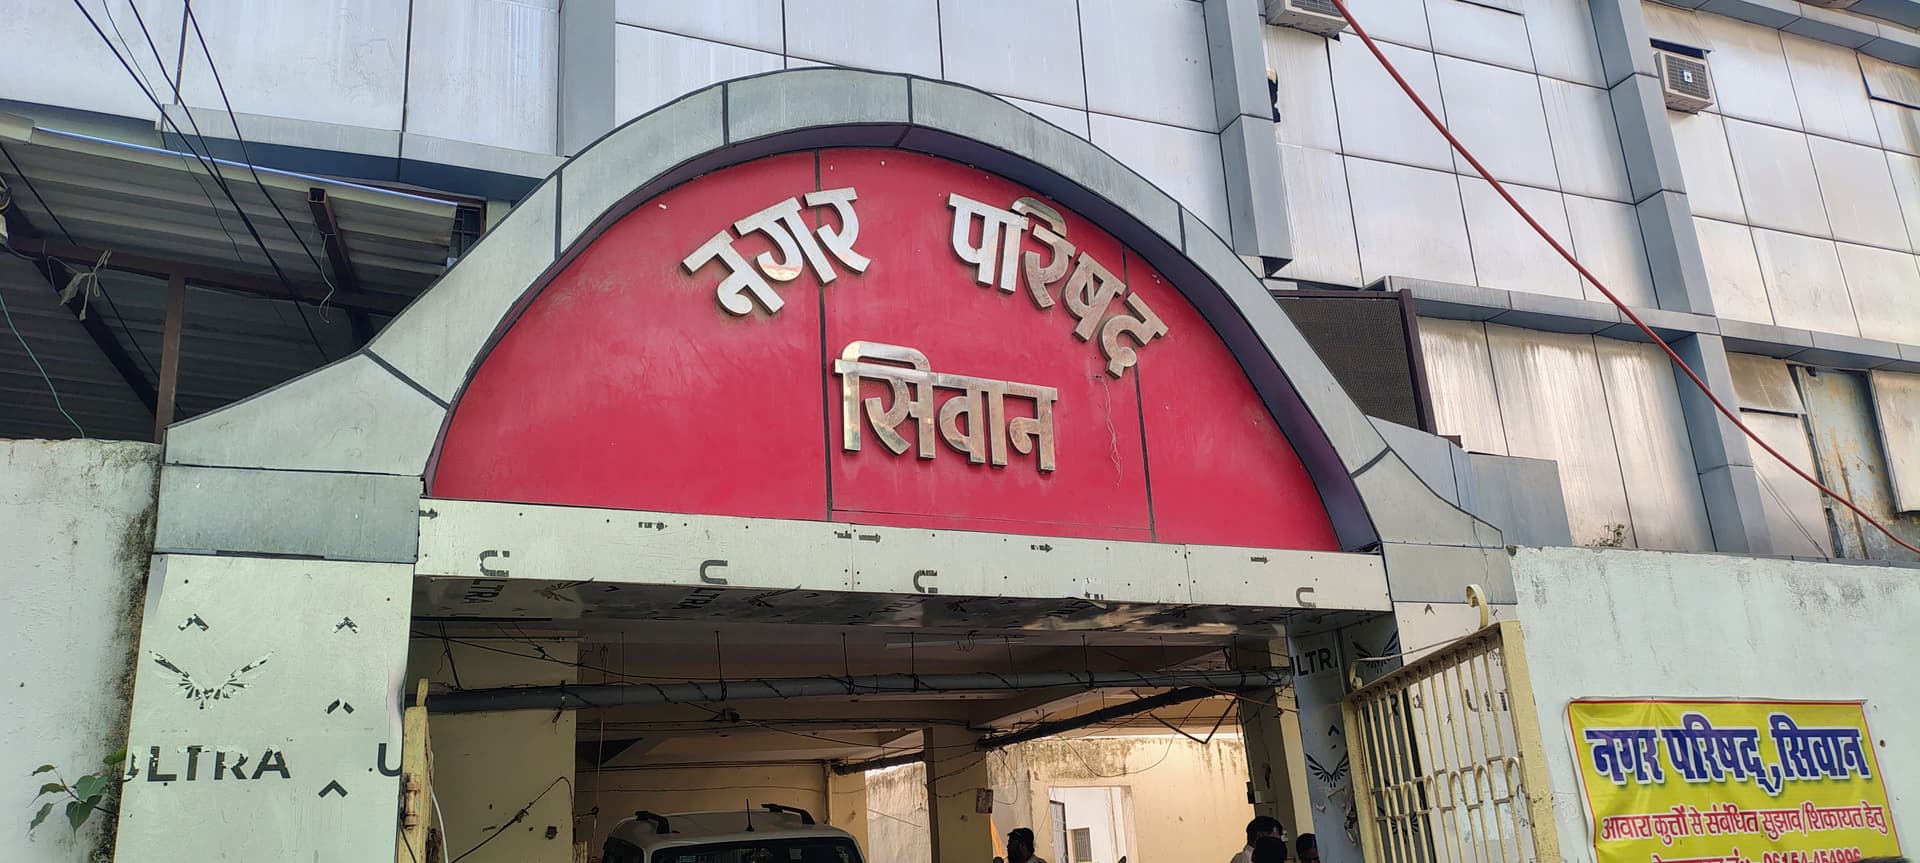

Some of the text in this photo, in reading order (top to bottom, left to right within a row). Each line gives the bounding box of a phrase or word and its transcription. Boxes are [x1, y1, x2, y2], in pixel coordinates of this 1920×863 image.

[682, 187, 1168, 378] नगर परिषद
[834, 340, 1058, 472] सिवान
[1585, 729, 1664, 783] नगर
[1601, 815, 1653, 839] आवारा
[1652, 805, 1690, 845] कुत्तों
[1689, 806, 1704, 834] से
[1704, 804, 1760, 833] संबंधित
[1862, 800, 1888, 834] हेतु
